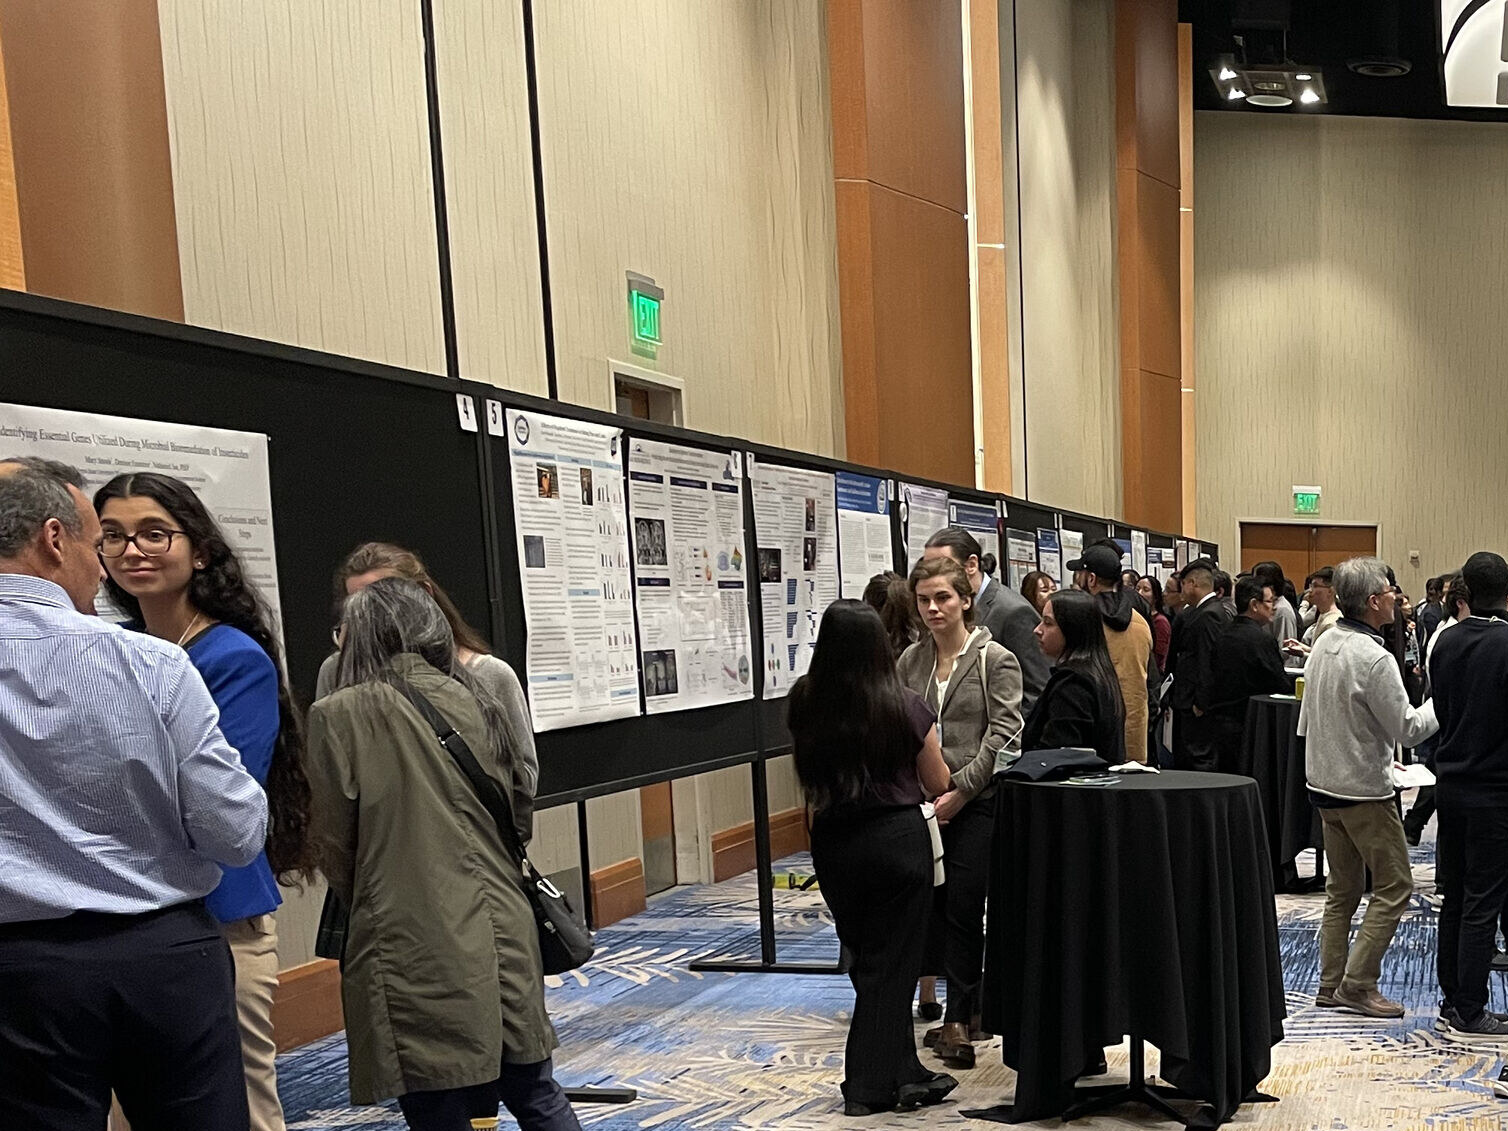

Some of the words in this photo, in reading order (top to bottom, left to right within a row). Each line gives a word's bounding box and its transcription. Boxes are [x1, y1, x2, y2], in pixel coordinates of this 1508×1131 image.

[463, 397, 470, 420] 4
[491, 403, 497, 424] 5
[0, 425, 38, 441] dentifying
[40, 429, 70, 441] Essential
[71, 432, 91, 444] Genes
